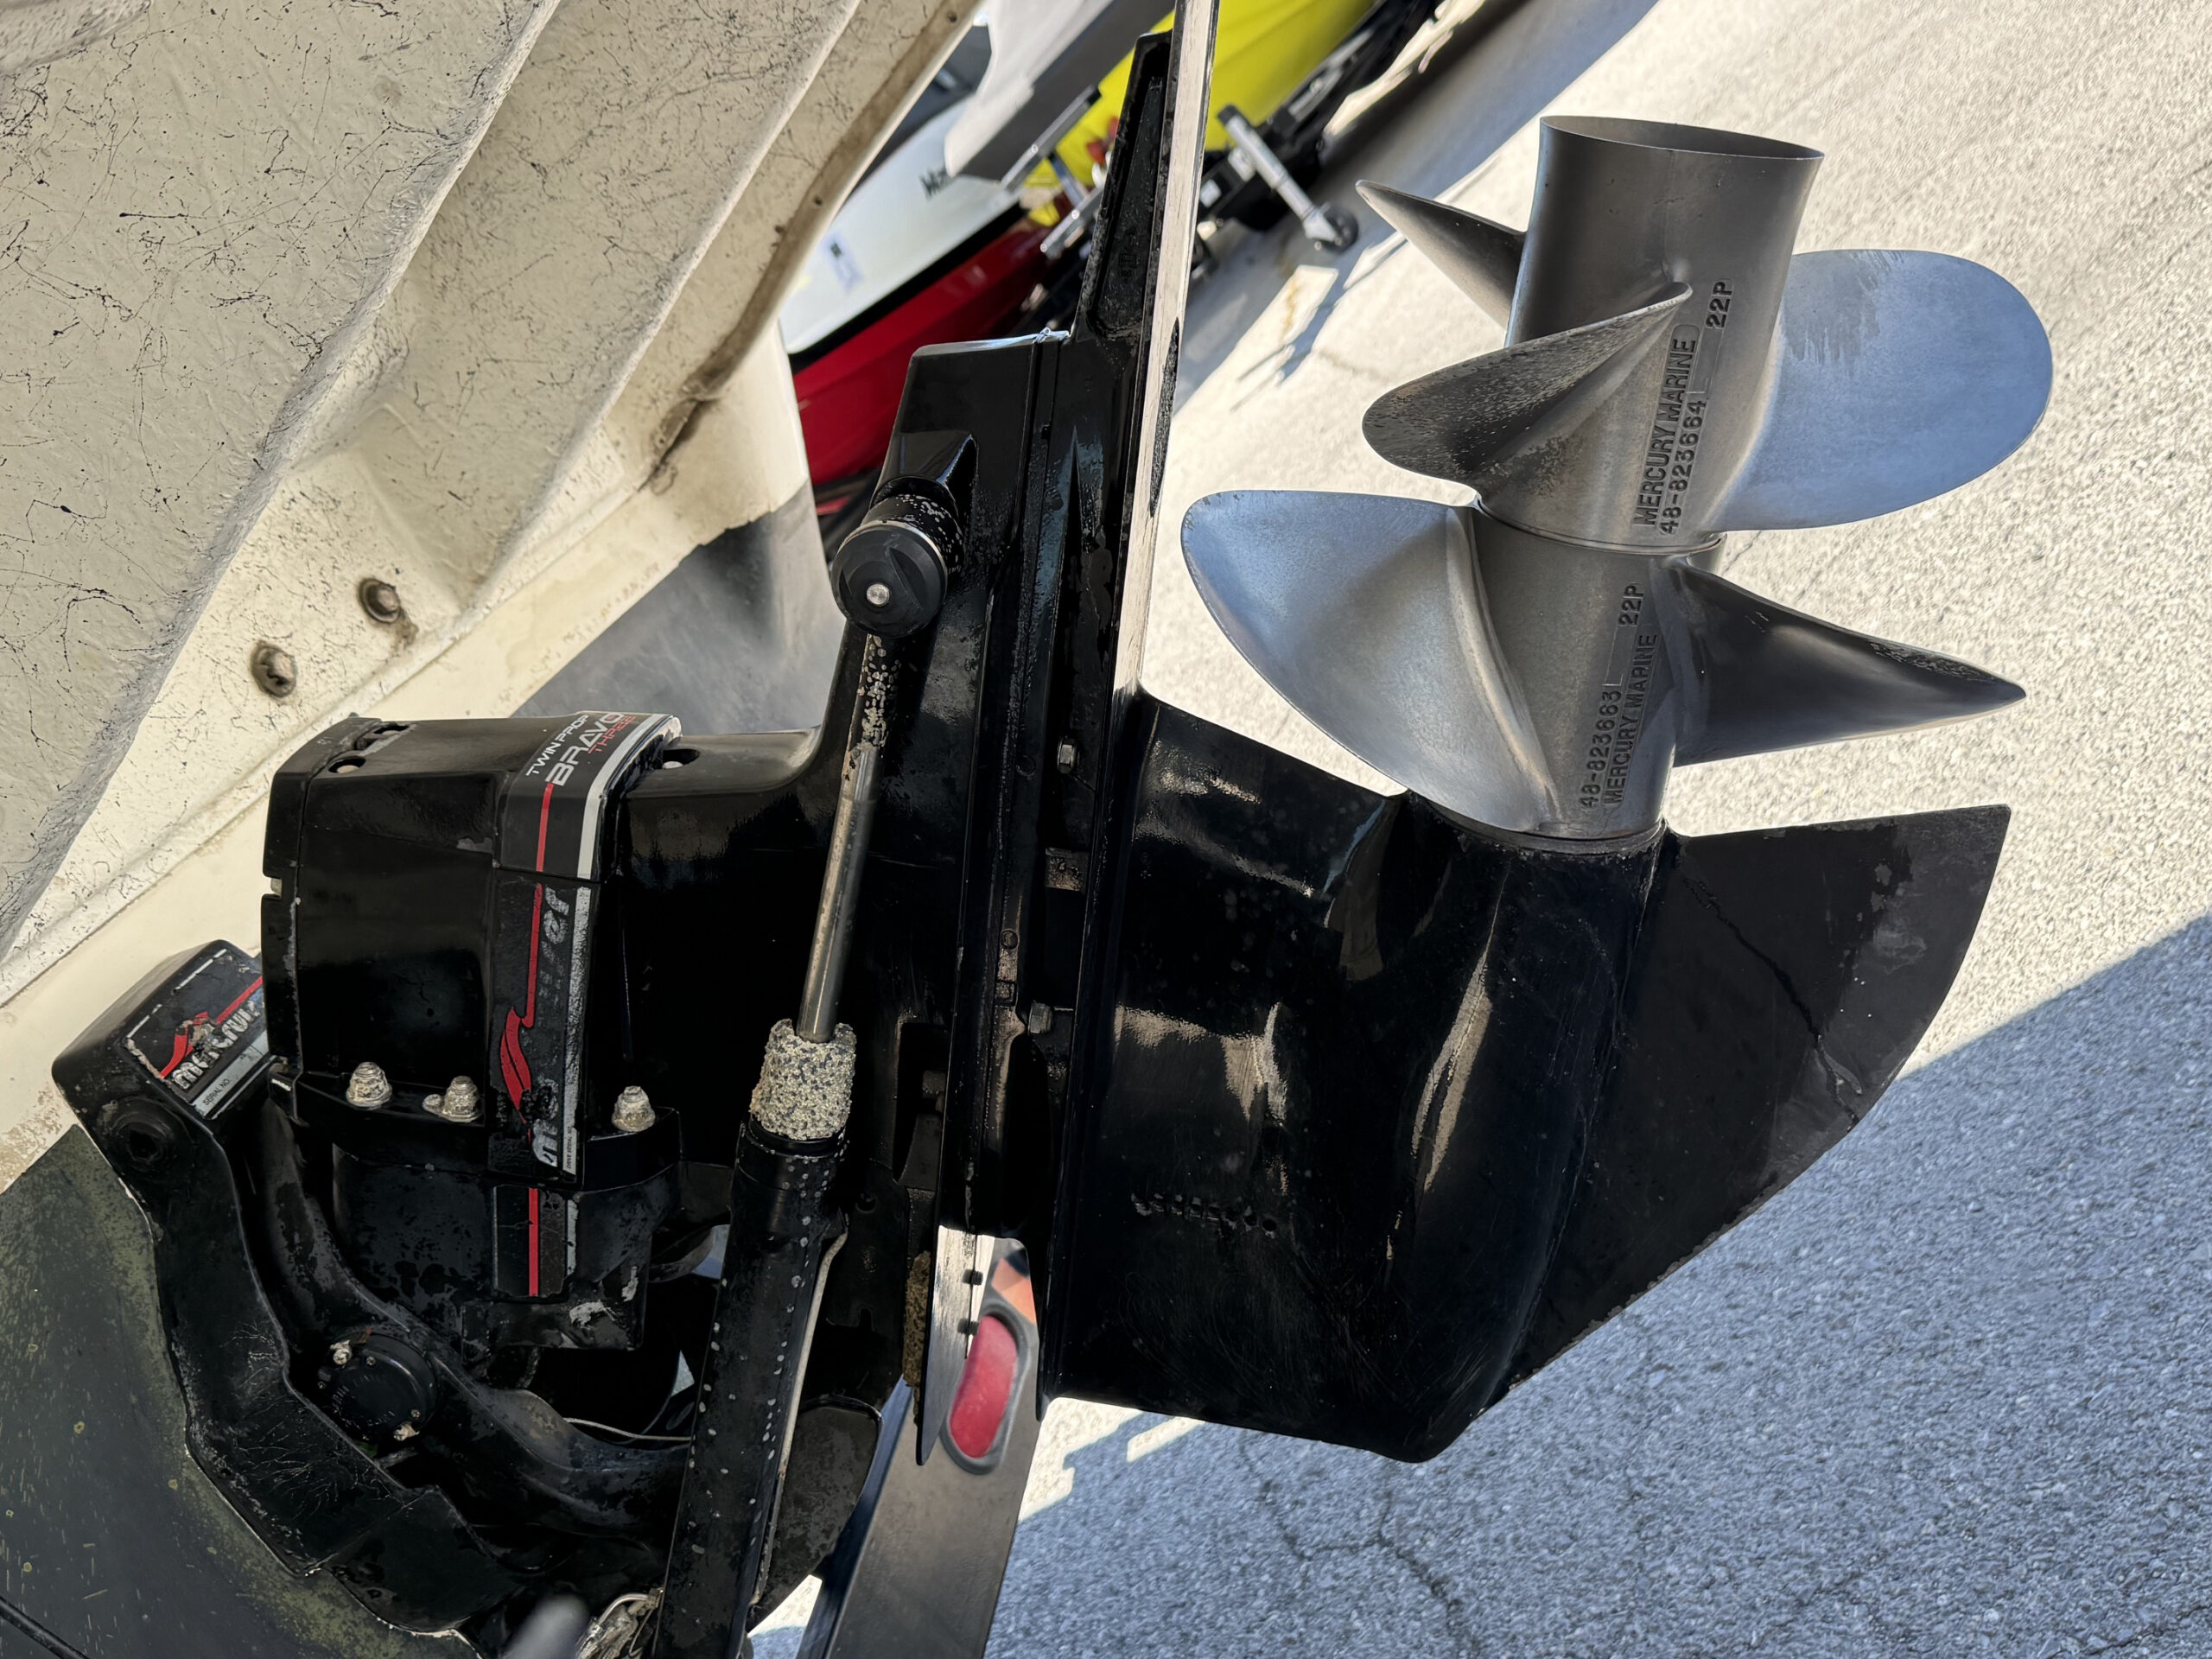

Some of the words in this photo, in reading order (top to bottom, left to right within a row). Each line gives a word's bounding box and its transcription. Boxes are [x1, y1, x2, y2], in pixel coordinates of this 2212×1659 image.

[1634, 425, 1676, 525] MERCURY
[1656, 338, 1696, 423] MARINE
[1658, 399, 1707, 536] 48-823664
[1705, 280, 1733, 329] 22P
[525, 741, 562, 776] TWIN
[554, 714, 589, 743] PROP
[545, 712, 625, 786] BRAVO
[588, 715, 637, 754] THREE
[1578, 690, 1622, 810] 48-823663
[1618, 583, 1644, 626] 22P
[1603, 715, 1640, 805] MERCURY
[1624, 633, 1658, 709] MARINE
[202, 1087, 223, 1106] SERIAL
